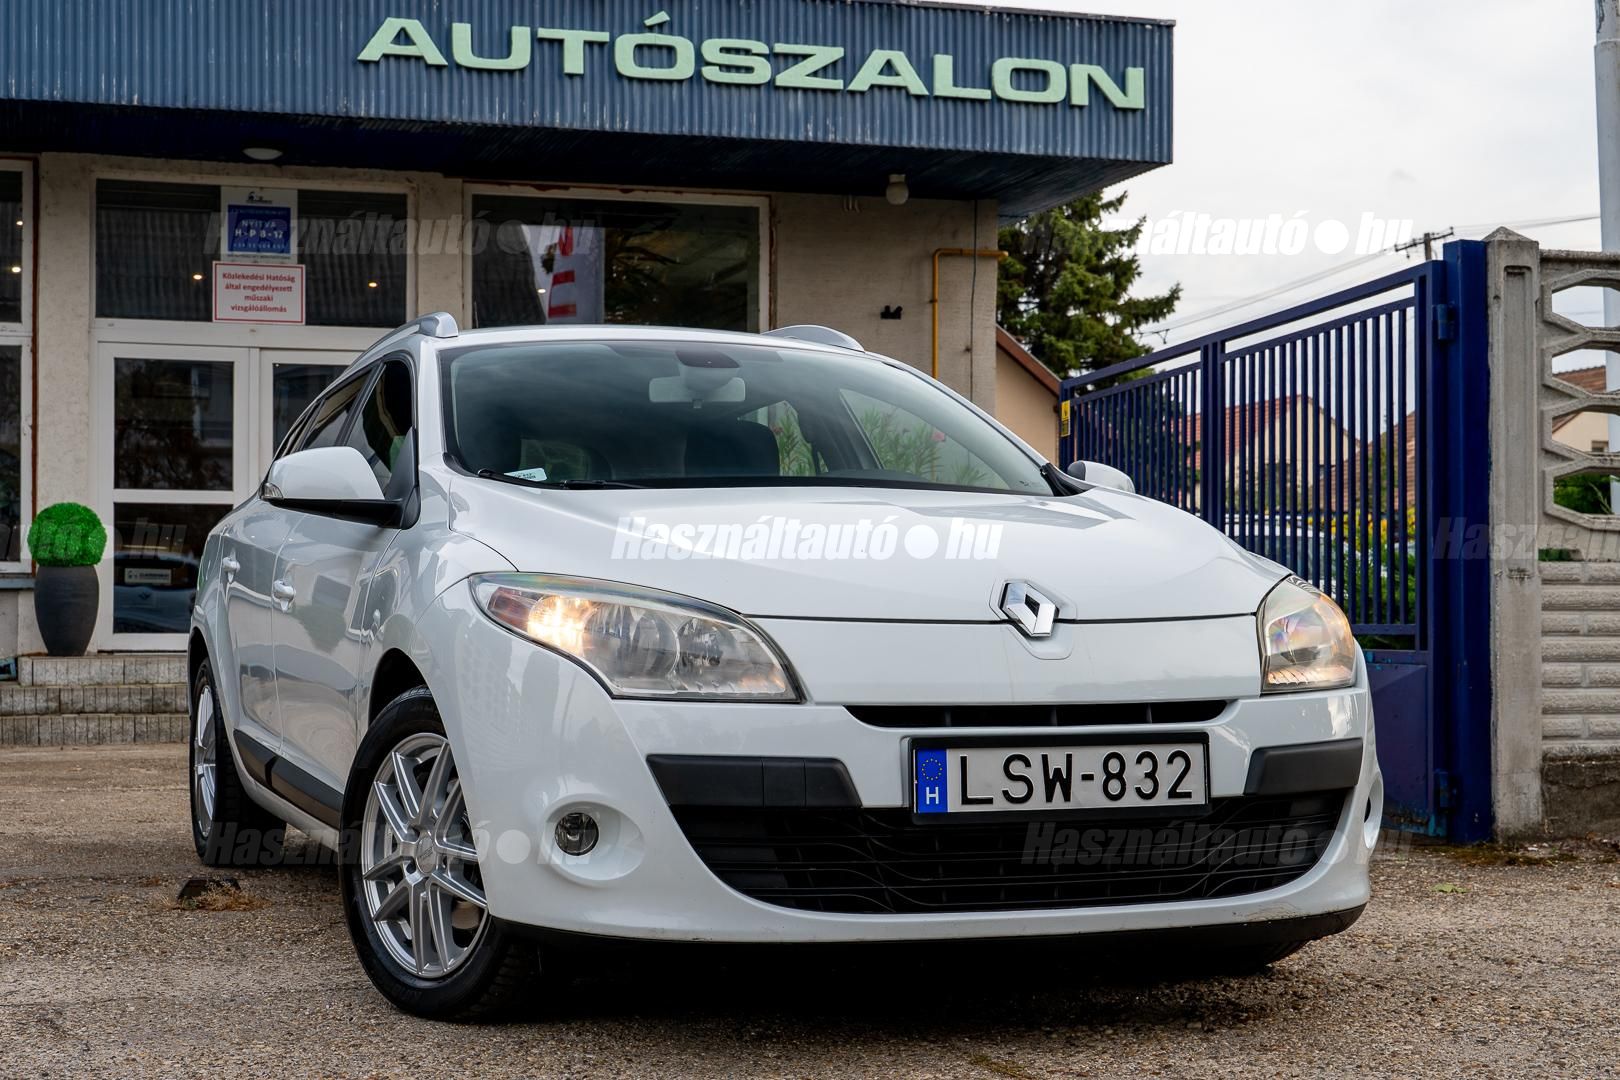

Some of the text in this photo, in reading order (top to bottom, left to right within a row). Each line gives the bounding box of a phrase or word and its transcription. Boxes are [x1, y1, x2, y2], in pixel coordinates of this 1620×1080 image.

[356, 11, 1145, 110] AUTÓSZALON
[241, 220, 277, 228] NYITVA
[222, 272, 296, 283] Közlekedési Hatóság
[225, 282, 293, 293] által engedélyezett
[244, 294, 273, 302] műszaki
[231, 303, 287, 313] vizsgálóállomás
[960, 749, 1192, 806] LSW-832
[926, 786, 940, 805] H
